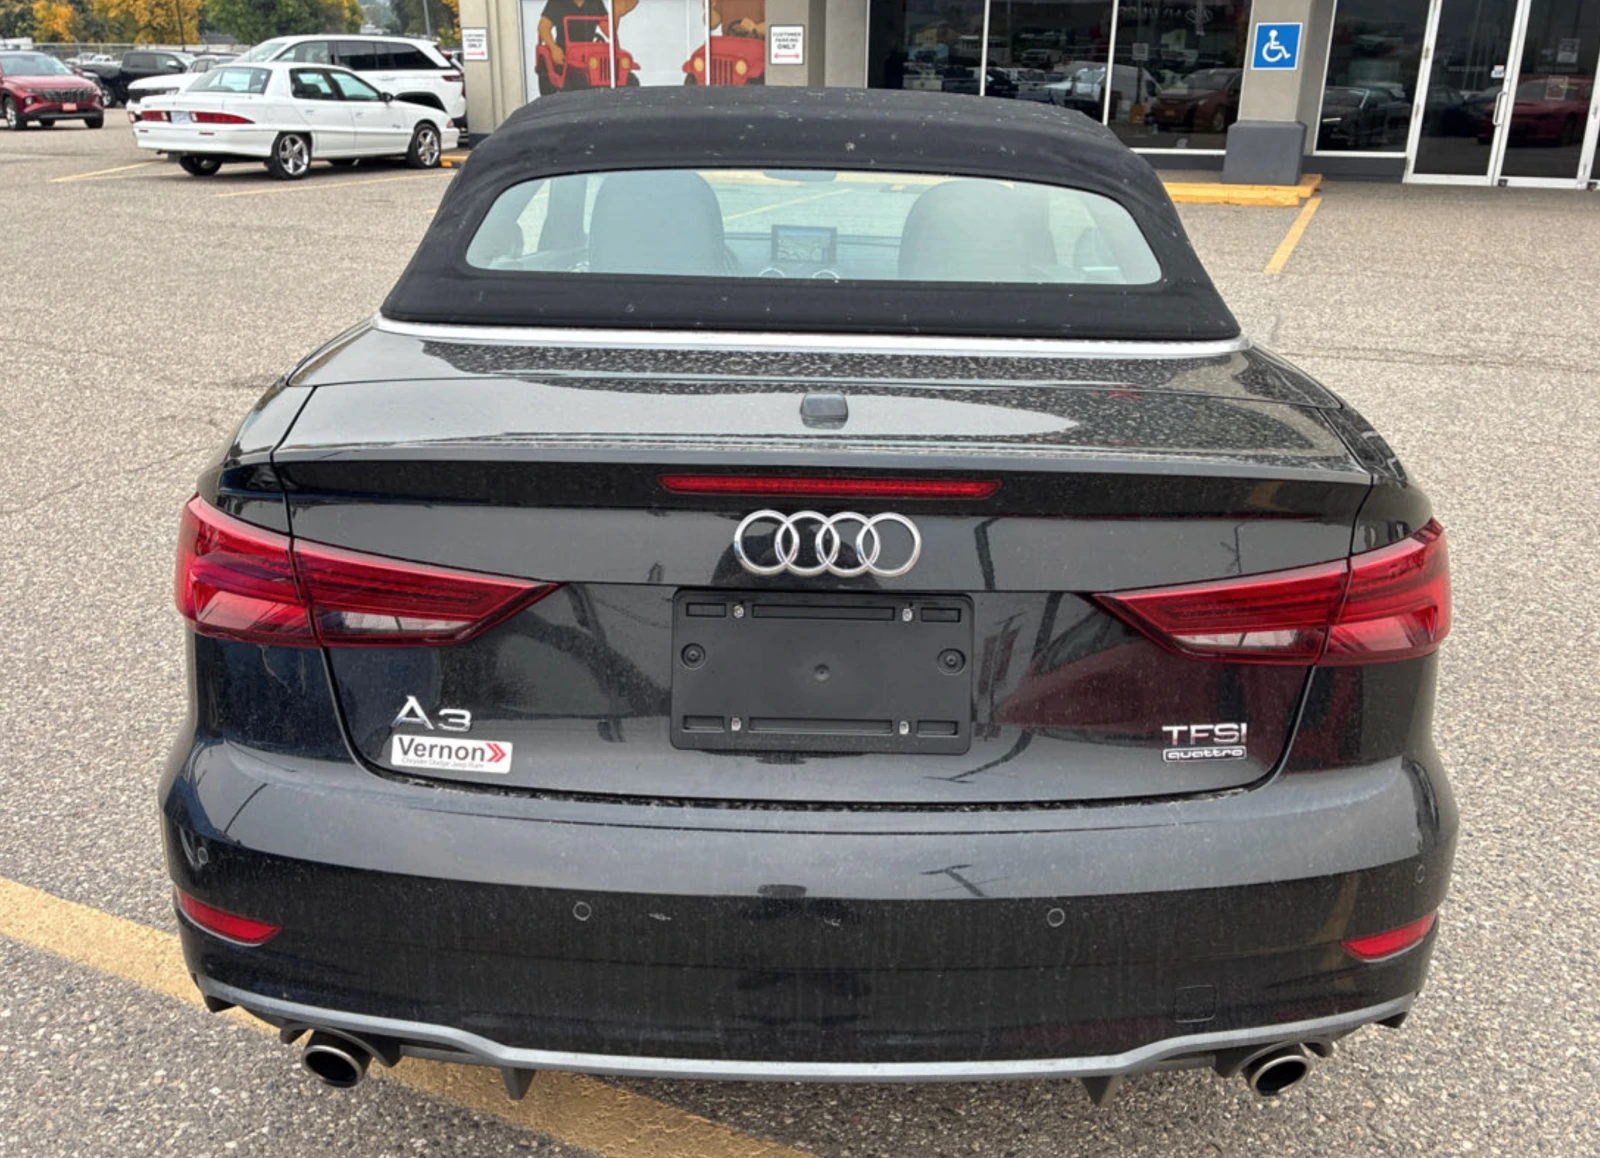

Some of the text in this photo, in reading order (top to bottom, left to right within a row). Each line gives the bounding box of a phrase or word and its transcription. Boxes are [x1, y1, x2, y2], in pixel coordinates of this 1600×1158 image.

[391, 695, 471, 732] A3
[1162, 722, 1248, 745] TFSI
[398, 737, 486, 762] Vernon
[1167, 748, 1243, 761] quattro
